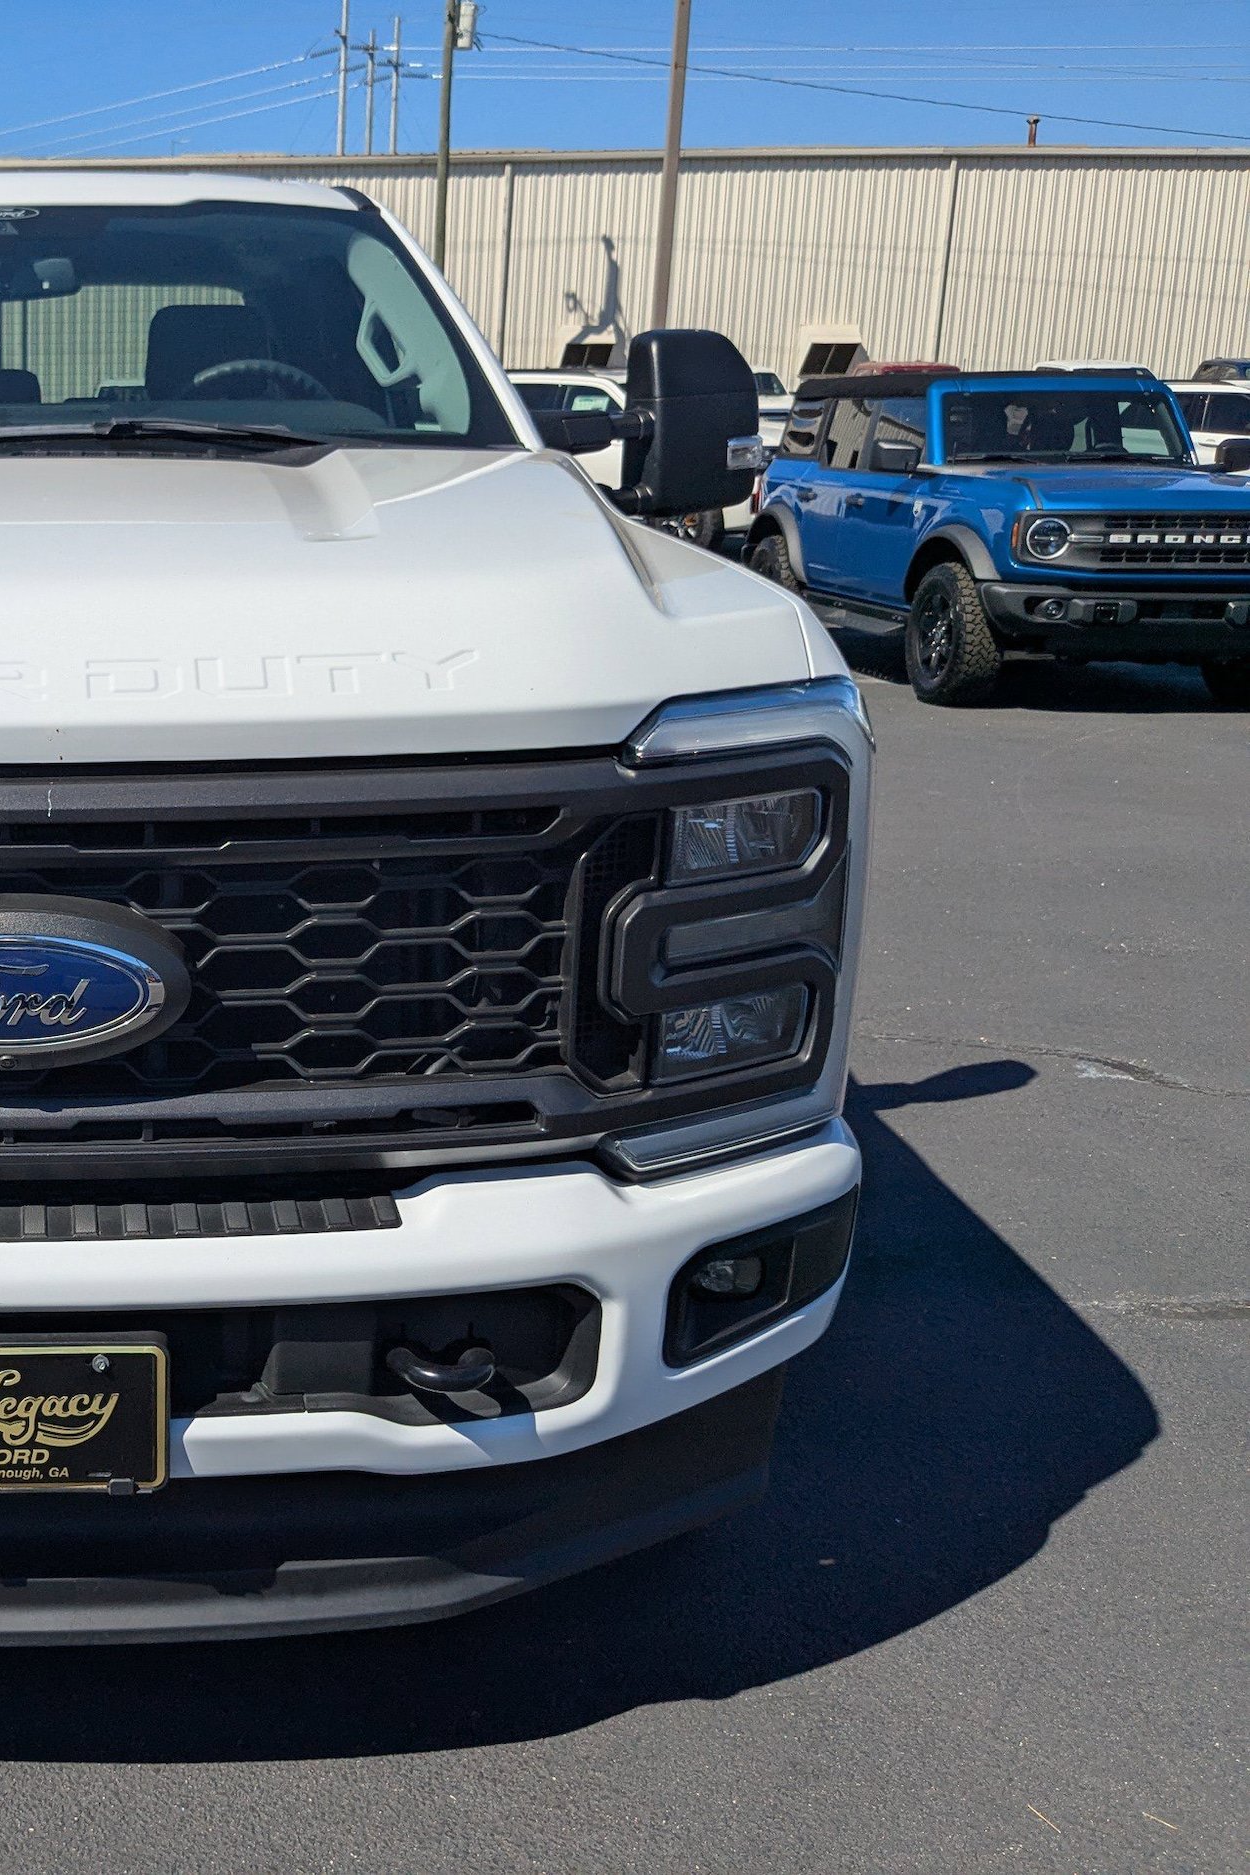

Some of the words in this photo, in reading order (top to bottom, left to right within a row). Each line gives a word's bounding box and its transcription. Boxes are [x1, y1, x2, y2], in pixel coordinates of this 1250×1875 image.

[1109, 534, 1250, 544] BRONC
[84, 649, 480, 700] DUTY
[48, 1466, 69, 1478] GA
